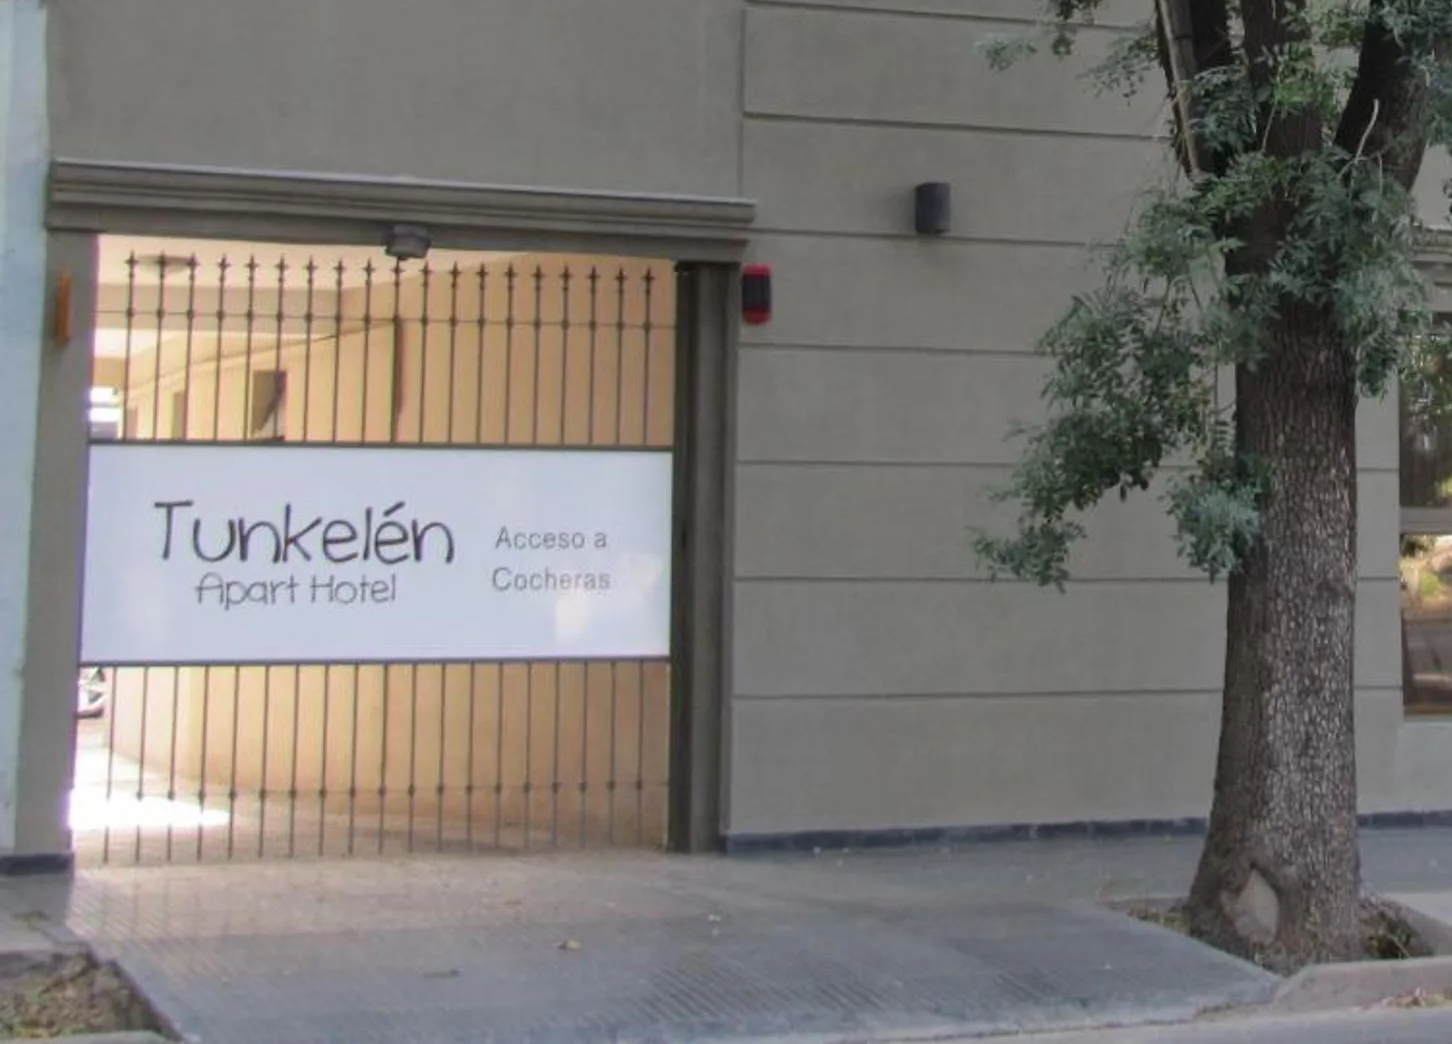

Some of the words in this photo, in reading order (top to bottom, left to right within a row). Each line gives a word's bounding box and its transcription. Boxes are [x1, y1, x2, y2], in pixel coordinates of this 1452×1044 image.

[154, 499, 456, 565] Tunkelén
[494, 526, 586, 551] Acceso
[593, 532, 609, 550] a
[195, 571, 300, 612] Apart
[309, 573, 399, 606] Hotel
[491, 566, 612, 593] Cocheras
